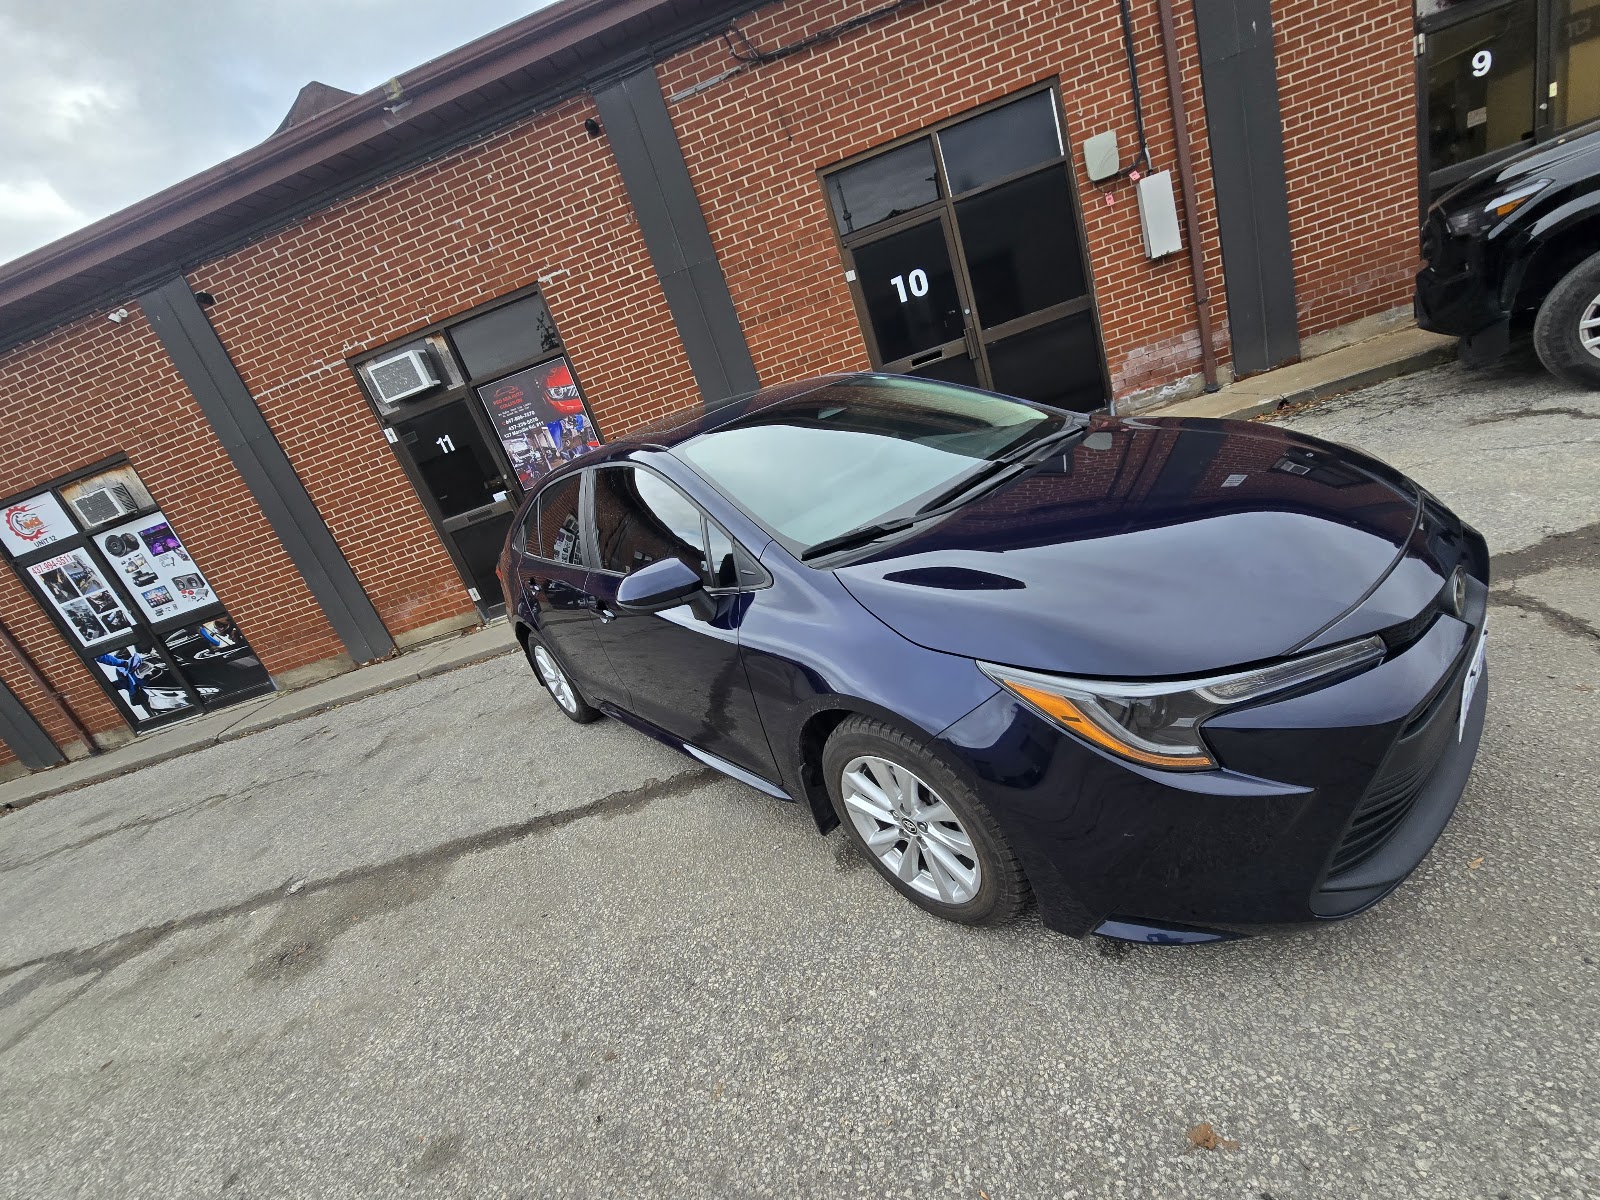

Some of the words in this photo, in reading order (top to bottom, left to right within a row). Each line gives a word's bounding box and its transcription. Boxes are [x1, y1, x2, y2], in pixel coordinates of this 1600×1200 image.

[1472, 50, 1492, 77] 9
[890, 268, 929, 303] 10
[436, 435, 455, 453] 11
[34, 538, 49, 547] UNIT
